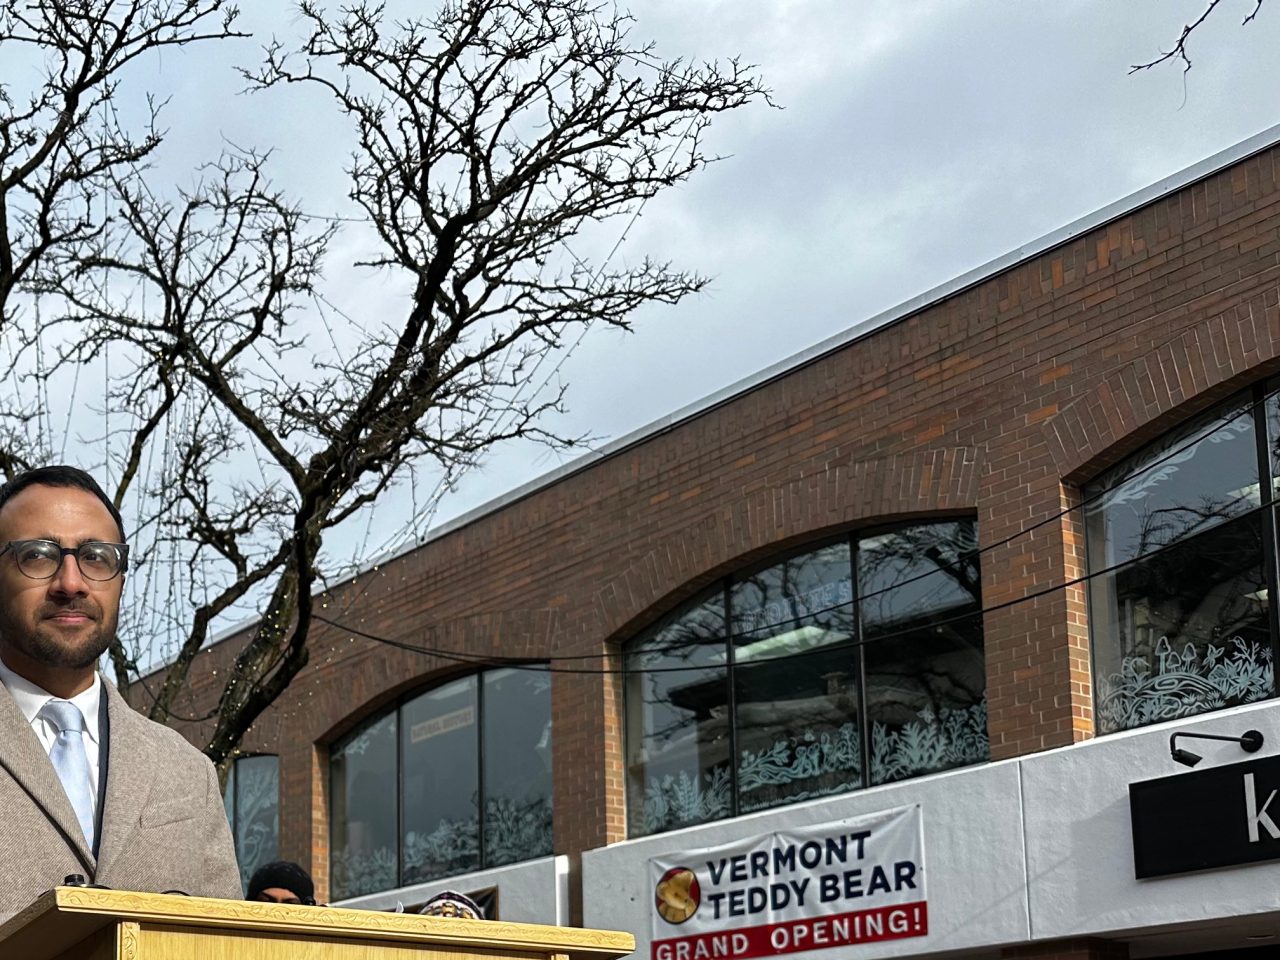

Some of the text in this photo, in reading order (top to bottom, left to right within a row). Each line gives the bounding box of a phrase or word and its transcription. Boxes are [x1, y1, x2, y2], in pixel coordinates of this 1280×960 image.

[706, 831, 872, 886] VERMONT
[708, 861, 917, 919] TEDDY BEAR
[771, 908, 921, 949] OPENING!
